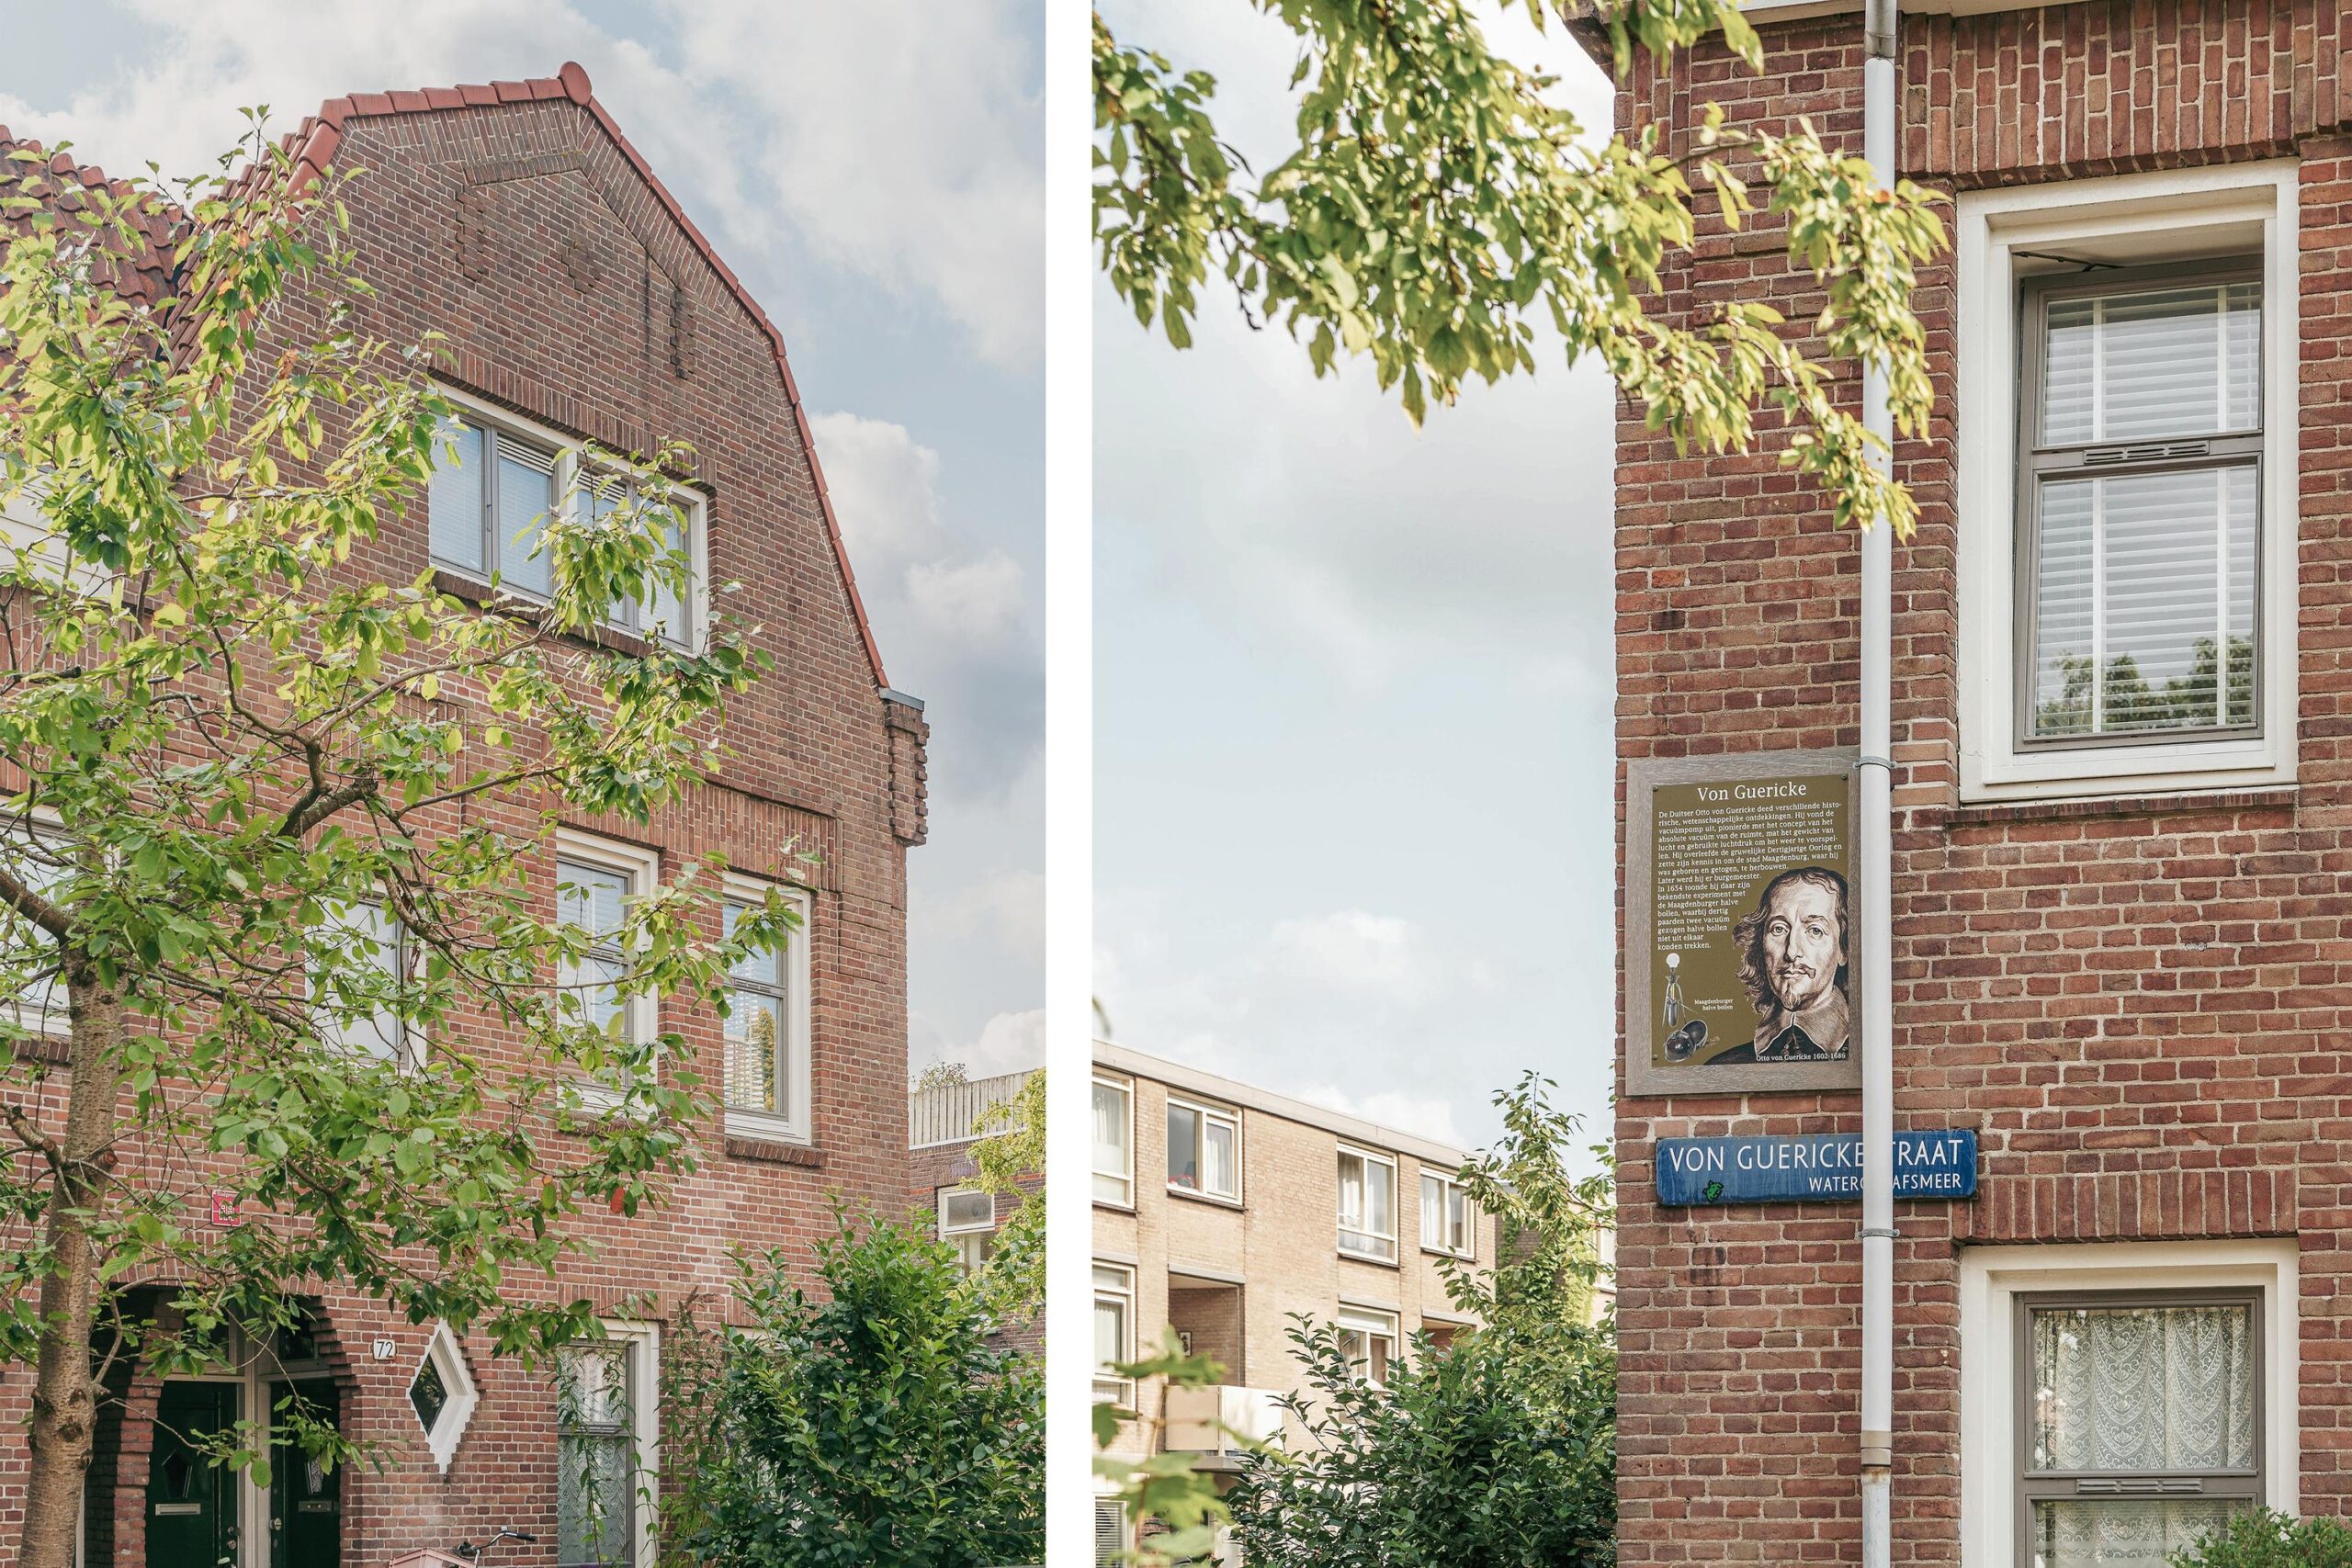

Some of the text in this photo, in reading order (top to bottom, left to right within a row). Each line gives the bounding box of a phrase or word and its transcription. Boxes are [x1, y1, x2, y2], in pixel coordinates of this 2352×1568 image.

[1698, 782, 1807, 801] Von Guericke
[1776, 803, 1820, 811] verschillende
[1683, 816, 1744, 825] wetenschappelijke
[1719, 824, 1750, 833] pionierde
[1780, 820, 1806, 829] concept
[1793, 828, 1820, 837] gewicht
[1687, 841, 1719, 851] gebruikte
[1721, 840, 1753, 848] luchtdruk
[1806, 835, 1838, 843] voorspel-
[1673, 852, 1682, 860] Hij
[1684, 850, 1719, 858] overleefde
[1731, 848, 1766, 857] gruwelijke
[1768, 846, 1807, 854] Dertigjarige
[1677, 860, 1690, 868] zijn
[1673, 868, 1700, 876] geboren
[1695, 875, 1703, 884] hij
[1710, 883, 1719, 891] hij
[1737, 882, 1750, 890] zijn
[1693, 891, 1731, 900] experiment
[1668, 901, 1719, 909] Maagdenburger
[1682, 908, 1707, 917] waarbij
[1658, 919, 1685, 927] paarden
[1669, 1139, 1964, 1172] VON GUERICKERAAT
[1809, 1173, 1962, 1192] WATERAFSMEER
[377, 1341, 393, 1358] 72
